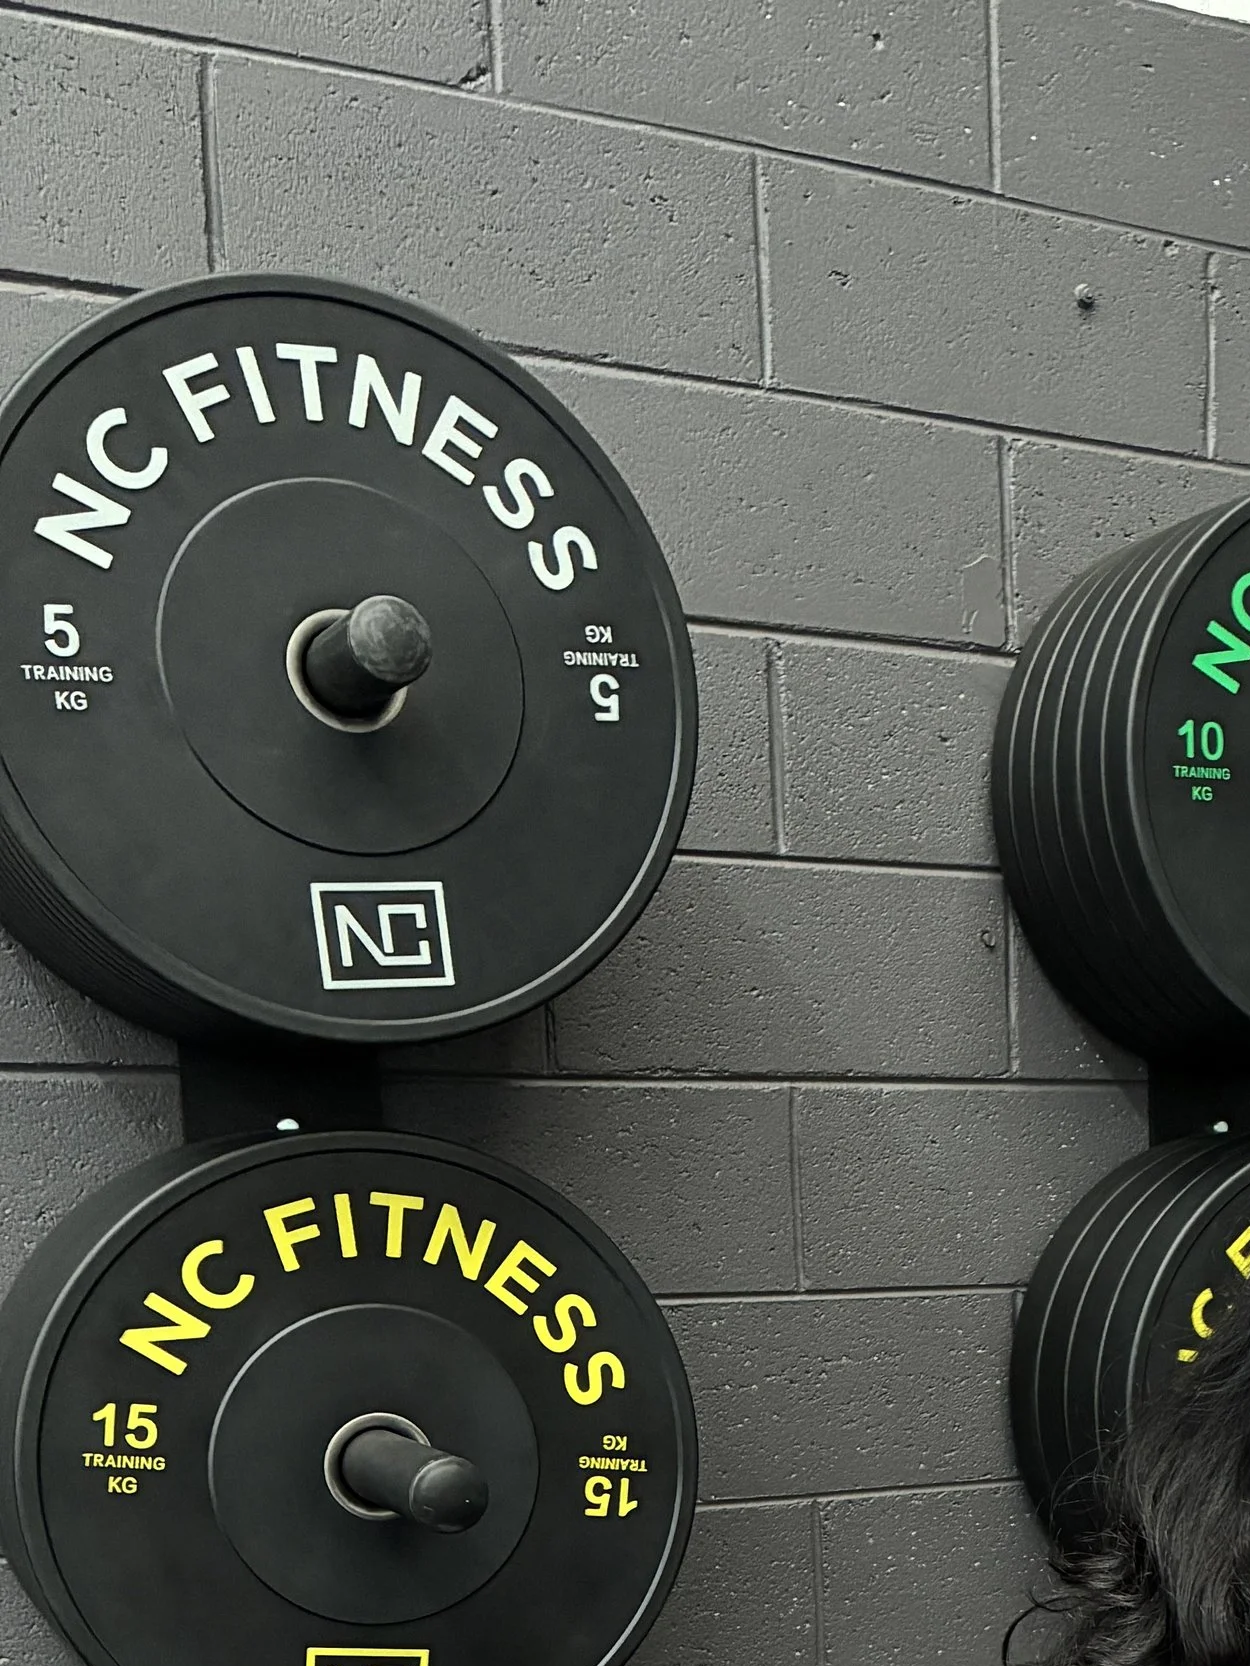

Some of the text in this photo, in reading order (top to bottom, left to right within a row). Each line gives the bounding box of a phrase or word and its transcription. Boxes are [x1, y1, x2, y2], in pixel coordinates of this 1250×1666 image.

[34, 343, 598, 590] NC FITNESS
[44, 604, 79, 656] 5
[585, 626, 612, 643] KG
[564, 651, 639, 667] TRAINING
[21, 665, 113, 682] TRAINING
[55, 691, 87, 710] KG
[590, 674, 619, 721] 5
[1179, 720, 1223, 760] 10
[1173, 766, 1230, 780] TRAINING
[1192, 787, 1212, 800] KG
[120, 1192, 625, 1405] NC FITNESS
[93, 1403, 157, 1449] 15
[603, 1435, 627, 1451] KG
[82, 1453, 165, 1470] TRAINING
[579, 1456, 647, 1471] TRAINING
[108, 1477, 137, 1493] KG
[585, 1476, 637, 1516] 15
